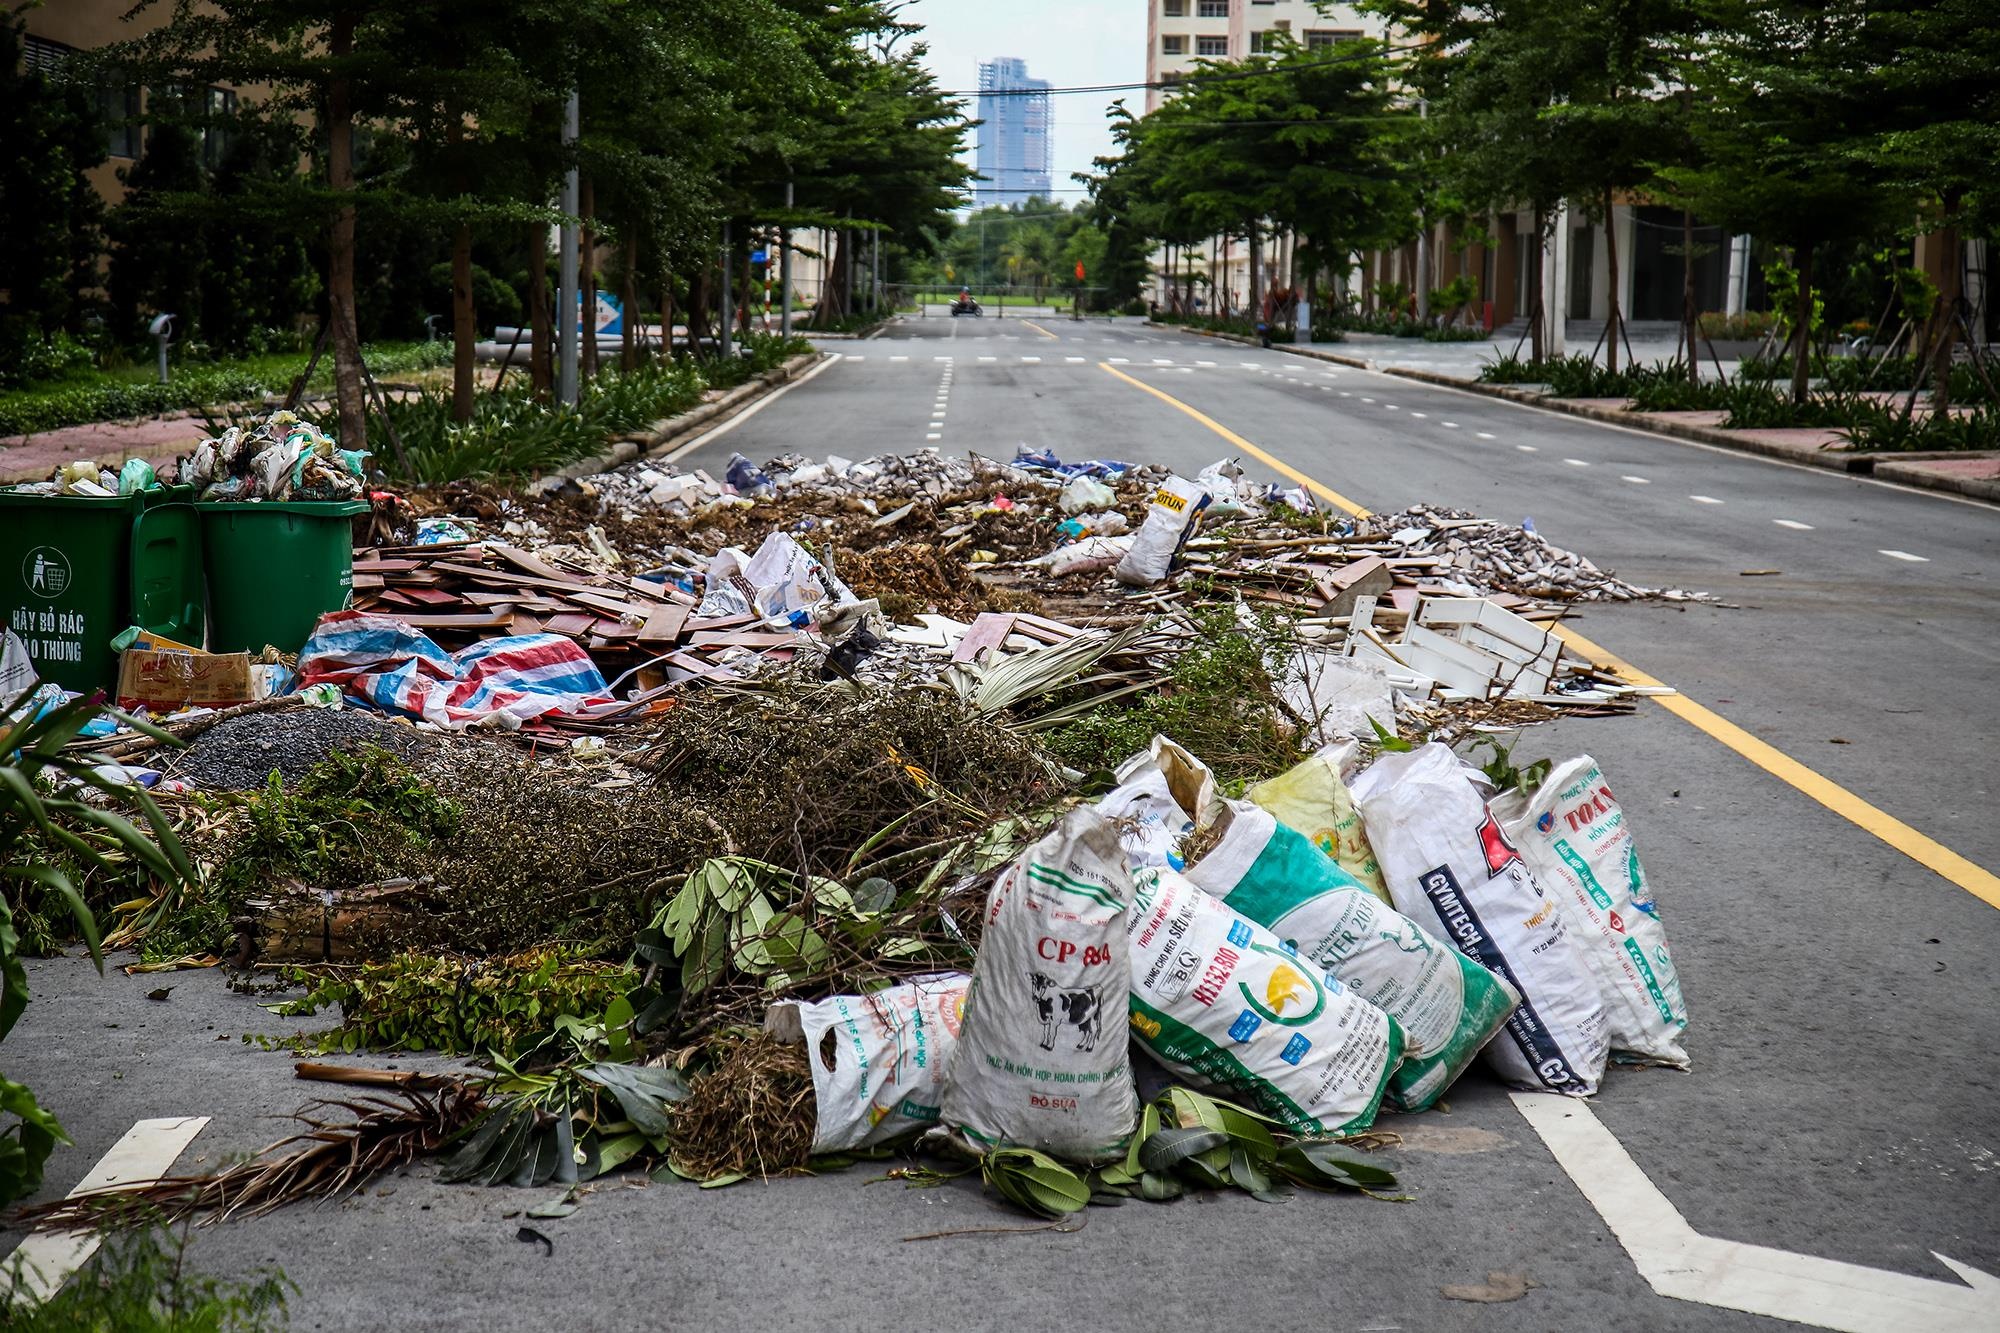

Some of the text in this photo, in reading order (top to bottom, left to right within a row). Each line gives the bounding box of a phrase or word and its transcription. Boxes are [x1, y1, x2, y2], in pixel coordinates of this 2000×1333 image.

[13, 606, 84, 634] HÃY BỎ RÁC
[23, 633, 81, 661] ÀO THÙNG
[1560, 784, 1582, 801] THỨC
[1588, 826, 1607, 842] HỖN
[1068, 860, 1085, 876] TCCS
[1593, 890, 1609, 907] VIÊN
[1428, 873, 1483, 948] GYMTECH
[1167, 916, 1189, 939] SIÊU
[1523, 912, 1545, 929] THỨC
[1137, 928, 1155, 948] THỨC
[1163, 939, 1177, 954] HEO
[1316, 935, 1331, 952] HỖN
[1037, 936, 1077, 963] CP
[1532, 945, 1540, 954] TỪ
[1540, 942, 1547, 950] 22
[1154, 953, 1169, 968] CHO
[1143, 967, 1159, 988] DÙNG
[1191, 947, 1240, 1007] H1132-BIO
[1405, 992, 1419, 1007] NGÀY
[854, 1036, 865, 1053] GIA
[914, 1029, 927, 1048] HỢP
[857, 1052, 869, 1069] ĂN
[912, 1049, 926, 1068] HỖN
[931, 1058, 942, 1084] DÙNG
[1004, 1060, 1015, 1072] ĂN
[1016, 1062, 1033, 1078] HỖN
[1035, 1069, 1052, 1082] HỢP
[1054, 1070, 1076, 1083] HOÀN
